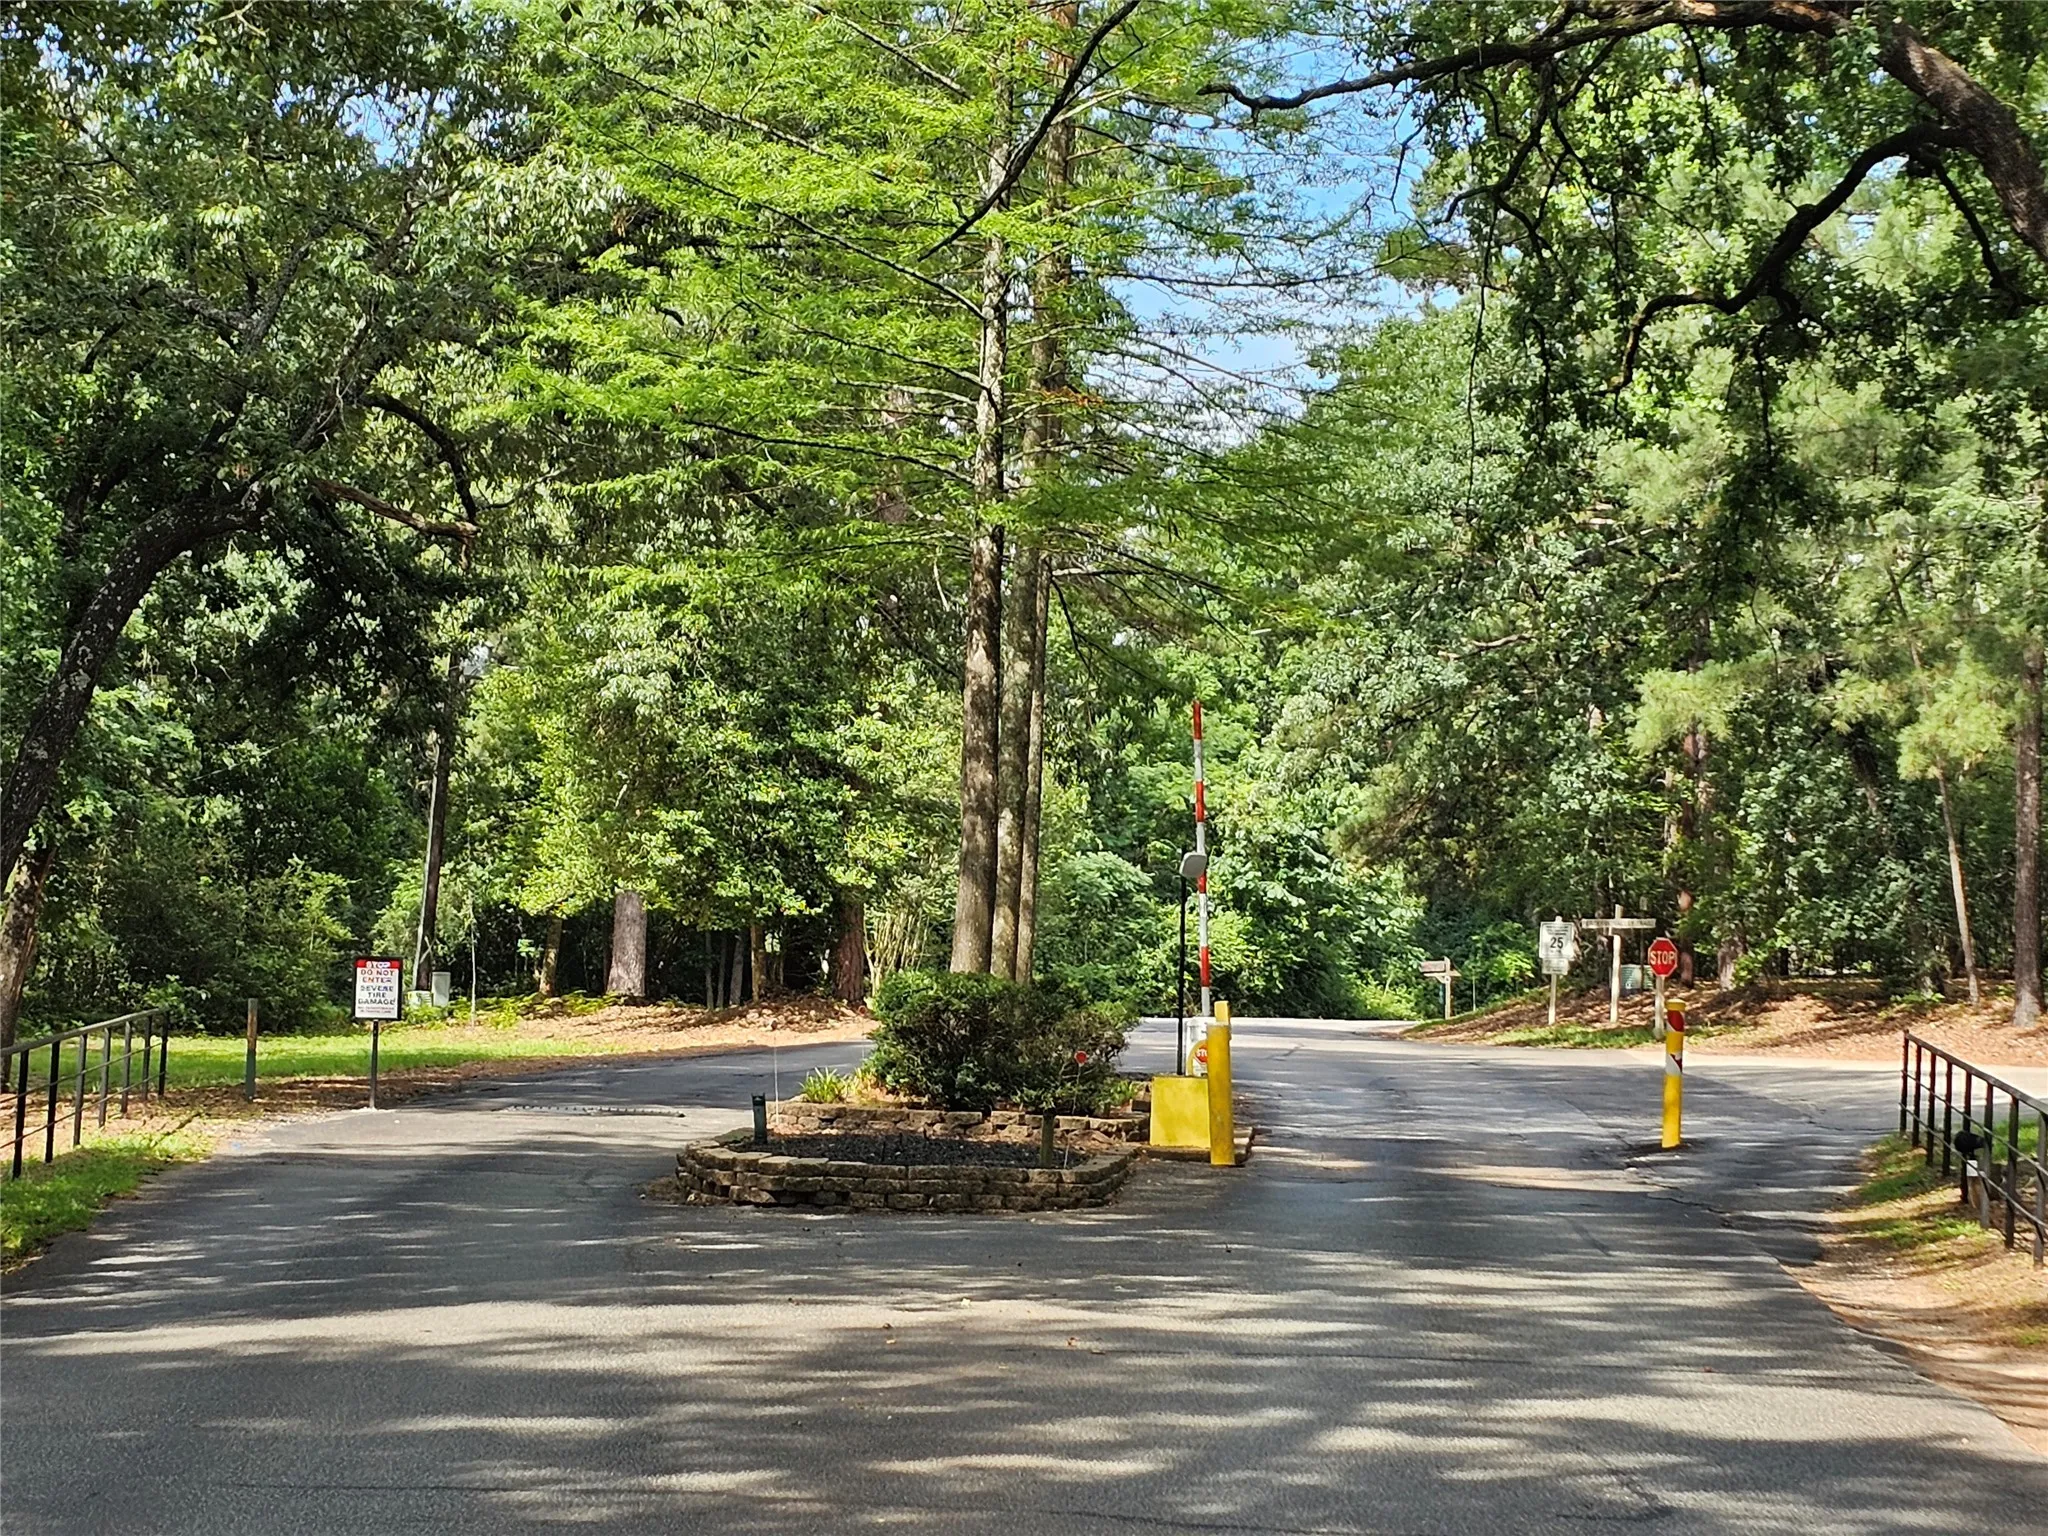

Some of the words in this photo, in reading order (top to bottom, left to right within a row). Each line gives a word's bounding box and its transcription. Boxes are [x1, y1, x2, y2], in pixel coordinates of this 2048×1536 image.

[1550, 937, 1564, 949] 25
[1650, 951, 1676, 965] STOP
[358, 998, 396, 1006] DAMAGE
